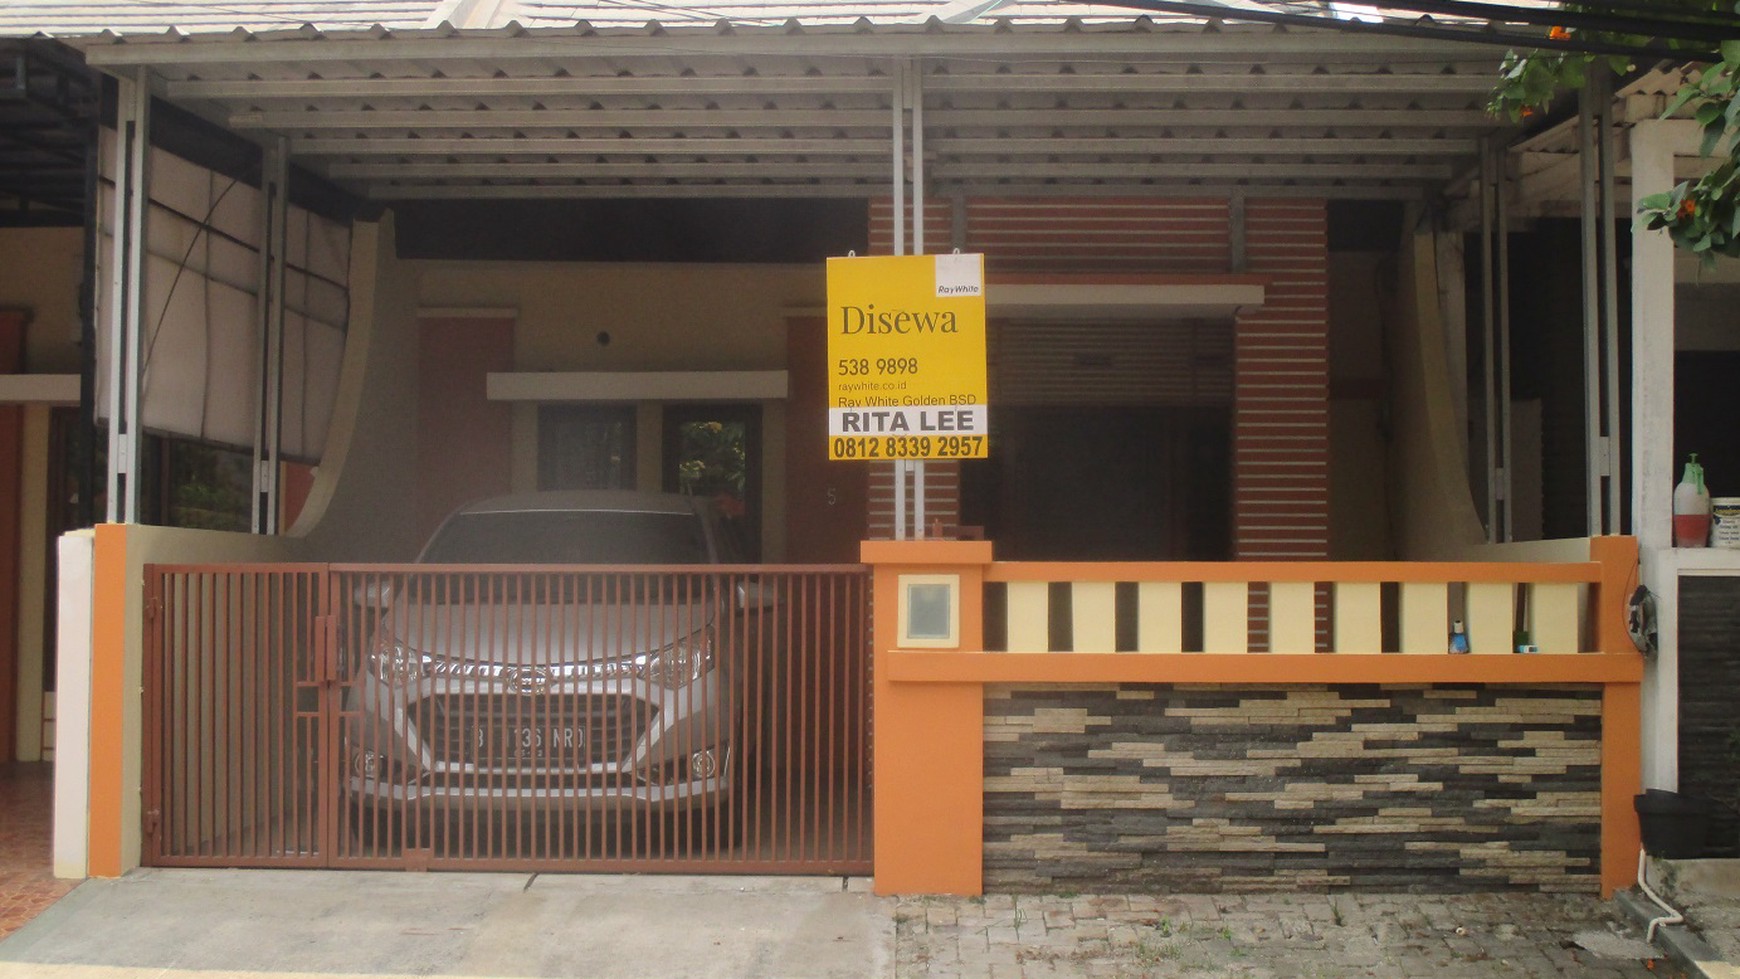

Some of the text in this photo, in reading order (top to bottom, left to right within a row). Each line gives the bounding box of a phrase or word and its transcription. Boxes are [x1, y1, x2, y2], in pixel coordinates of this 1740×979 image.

[841, 303, 958, 335] Disewa
[838, 357, 918, 376] 538 9898
[838, 381, 907, 393] raywhite.co.id
[838, 393, 977, 408] Ray White Golden BSD
[842, 410, 974, 432] RITA LEE
[834, 435, 983, 458] 0812 8339 2957
[827, 487, 836, 506] 5
